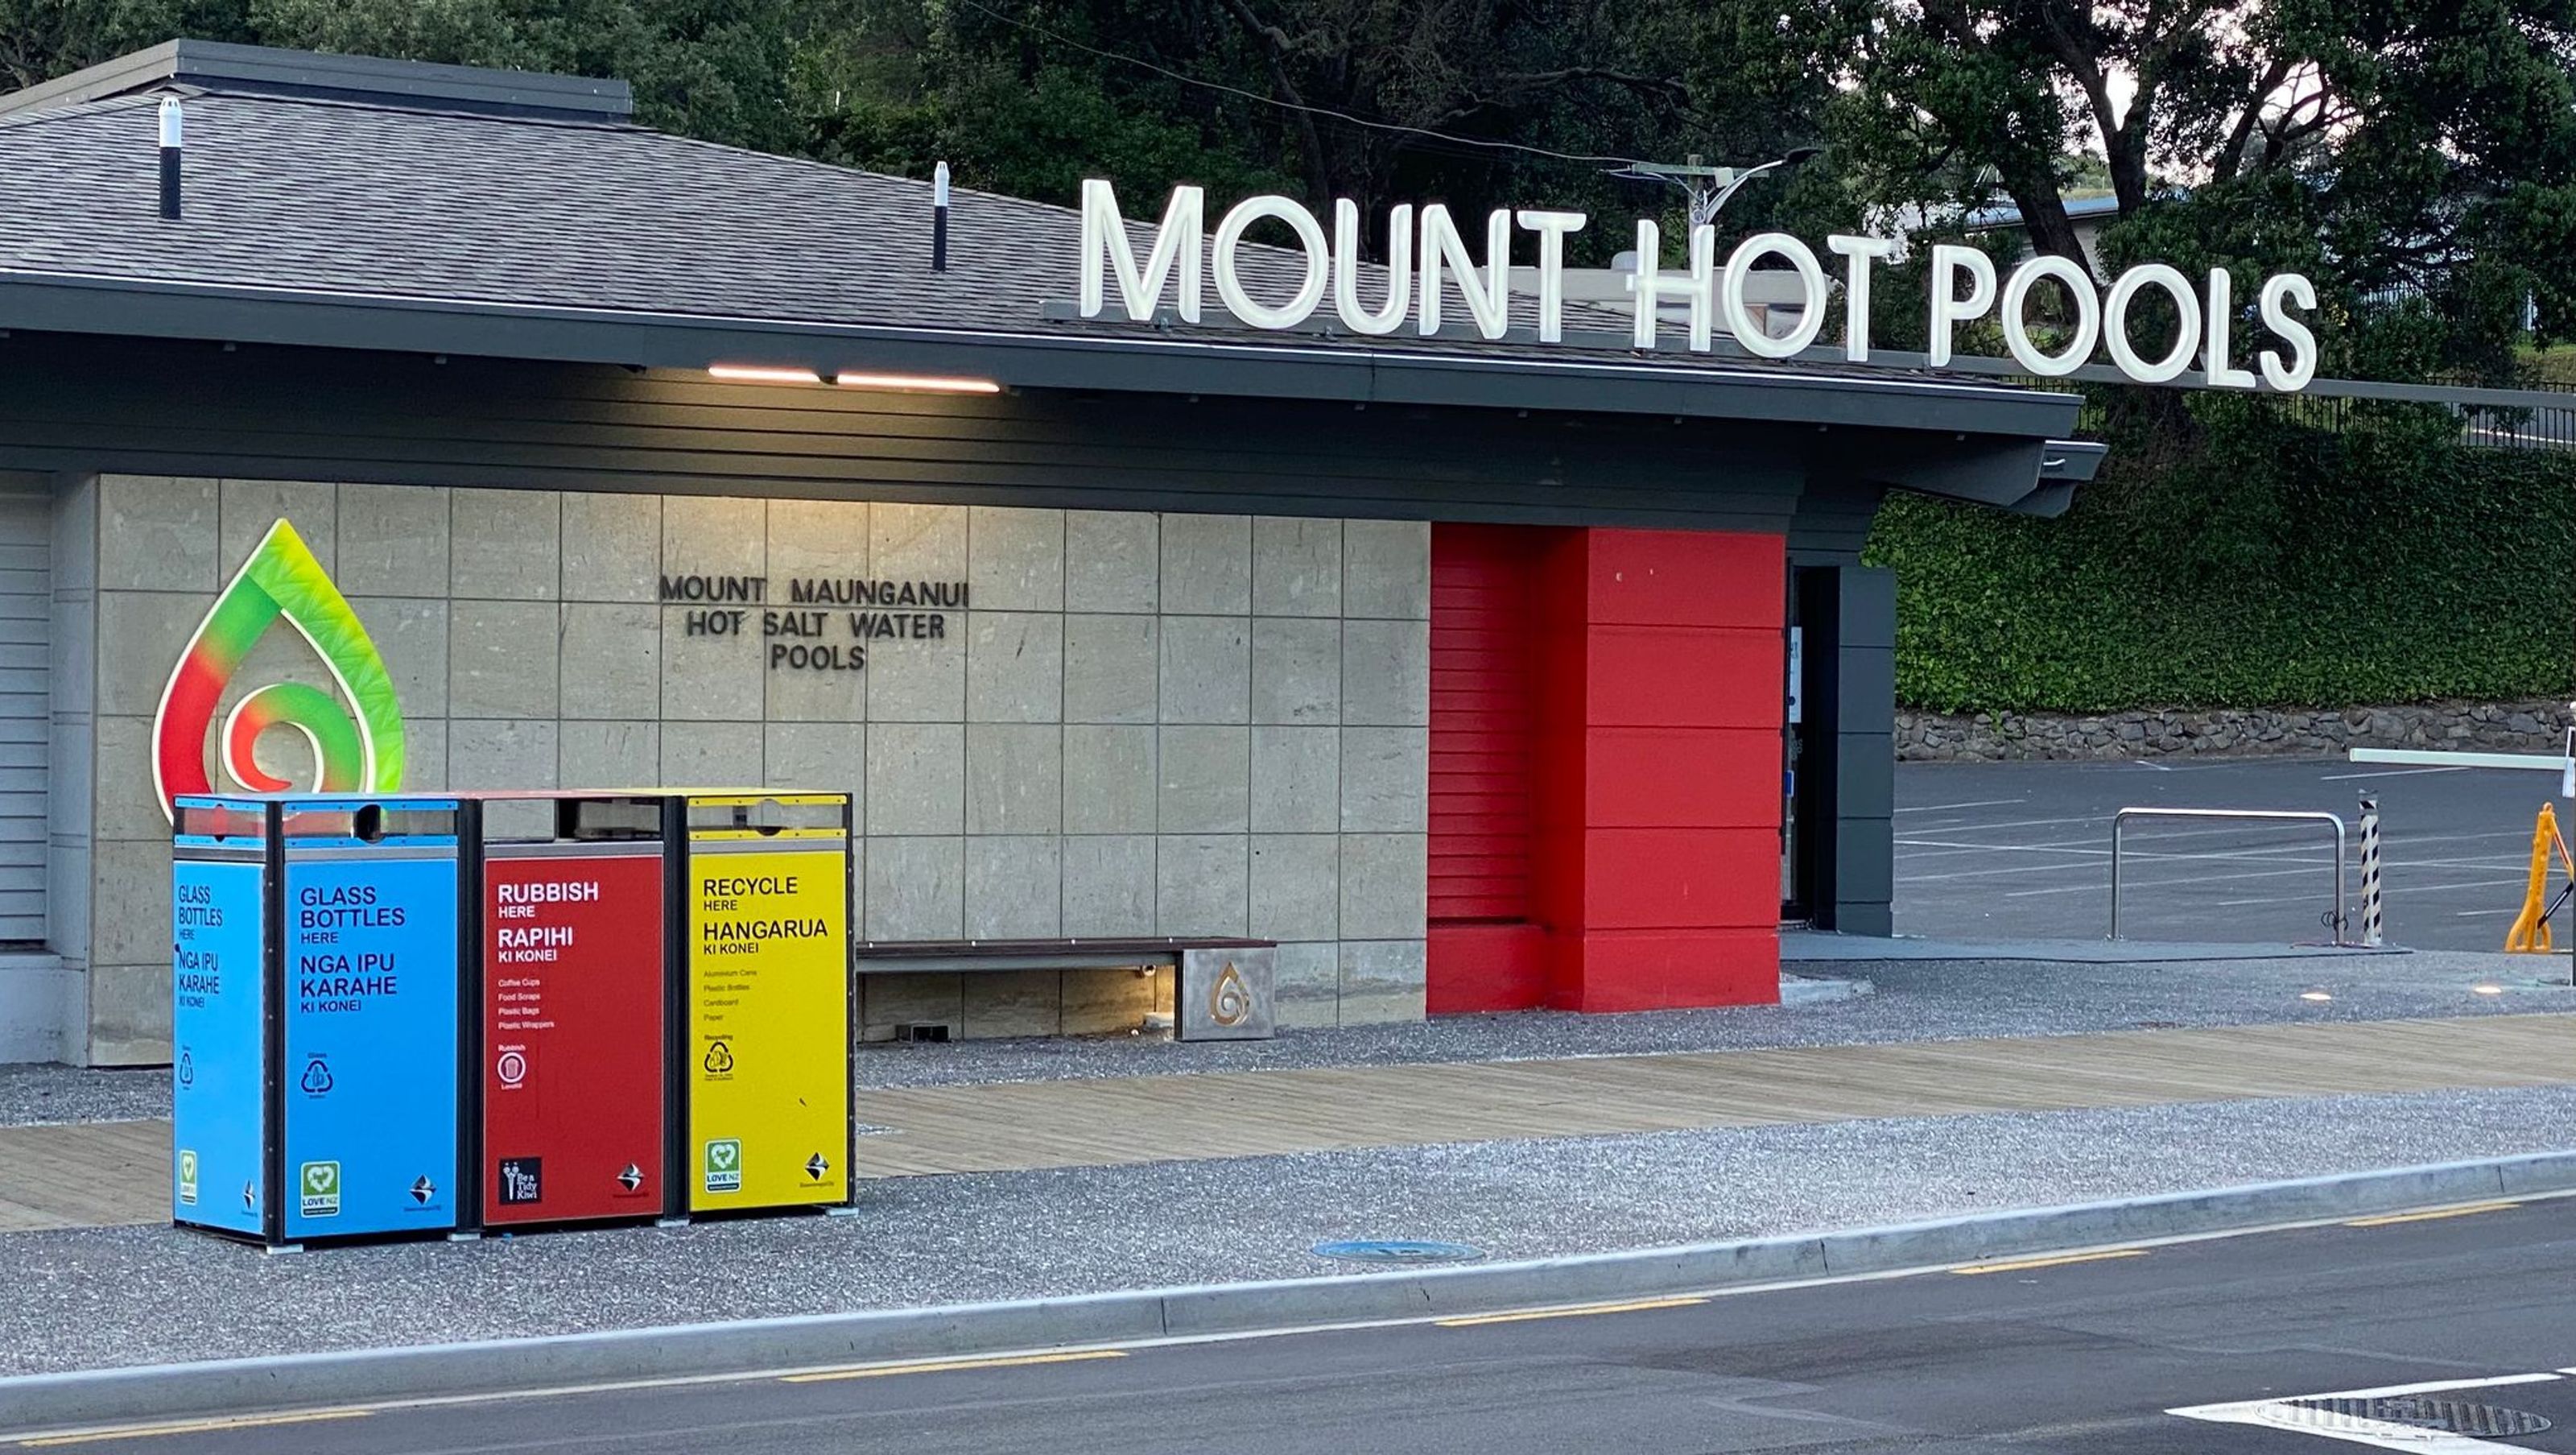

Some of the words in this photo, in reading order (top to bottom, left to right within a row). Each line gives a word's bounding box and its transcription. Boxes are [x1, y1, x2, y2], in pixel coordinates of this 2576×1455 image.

[1080, 178, 1587, 343] MOUNT
[1625, 218, 1891, 362] HOT
[1930, 244, 2318, 392] POOLS
[659, 575, 766, 601] MOUNT
[791, 578, 969, 607] MAUNGANUI
[687, 610, 746, 637] HOT
[763, 612, 828, 637] SALT
[849, 612, 945, 639] WATER
[770, 643, 865, 670] POOLS
[179, 885, 211, 904] GLASS
[300, 886, 376, 906] GLASS
[497, 882, 599, 903] RUBBISH
[704, 877, 798, 896] RECYCLE
[497, 905, 535, 919] HERE
[704, 899, 738, 911] HERE
[179, 907, 223, 926] BOTTLES
[300, 907, 406, 928] BOTTLES
[179, 928, 196, 940] HERE
[300, 932, 339, 944] HERE
[497, 927, 573, 948] RAPIHI
[704, 919, 828, 941] HANGARUA
[497, 951, 512, 963] KI
[515, 949, 557, 962] KONEI
[704, 944, 716, 955] KI
[720, 942, 759, 954] KONEI
[179, 951, 200, 969] NGA
[202, 953, 219, 972] IPU
[300, 955, 350, 973] NGA
[357, 953, 394, 973] IPU
[179, 973, 220, 994] KARAHE
[300, 977, 398, 998] KARAHE
[300, 1002, 314, 1013] KI
[318, 1000, 361, 1013] KONEI
[497, 993, 516, 1001] Food
[517, 1182, 538, 1192] Tidy
[708, 1174, 727, 1183] LOVE
[729, 1173, 740, 1182] NZ
[303, 1197, 324, 1206] LOVE
[326, 1197, 337, 1205] NZ
[517, 1190, 538, 1201] Kiwi
